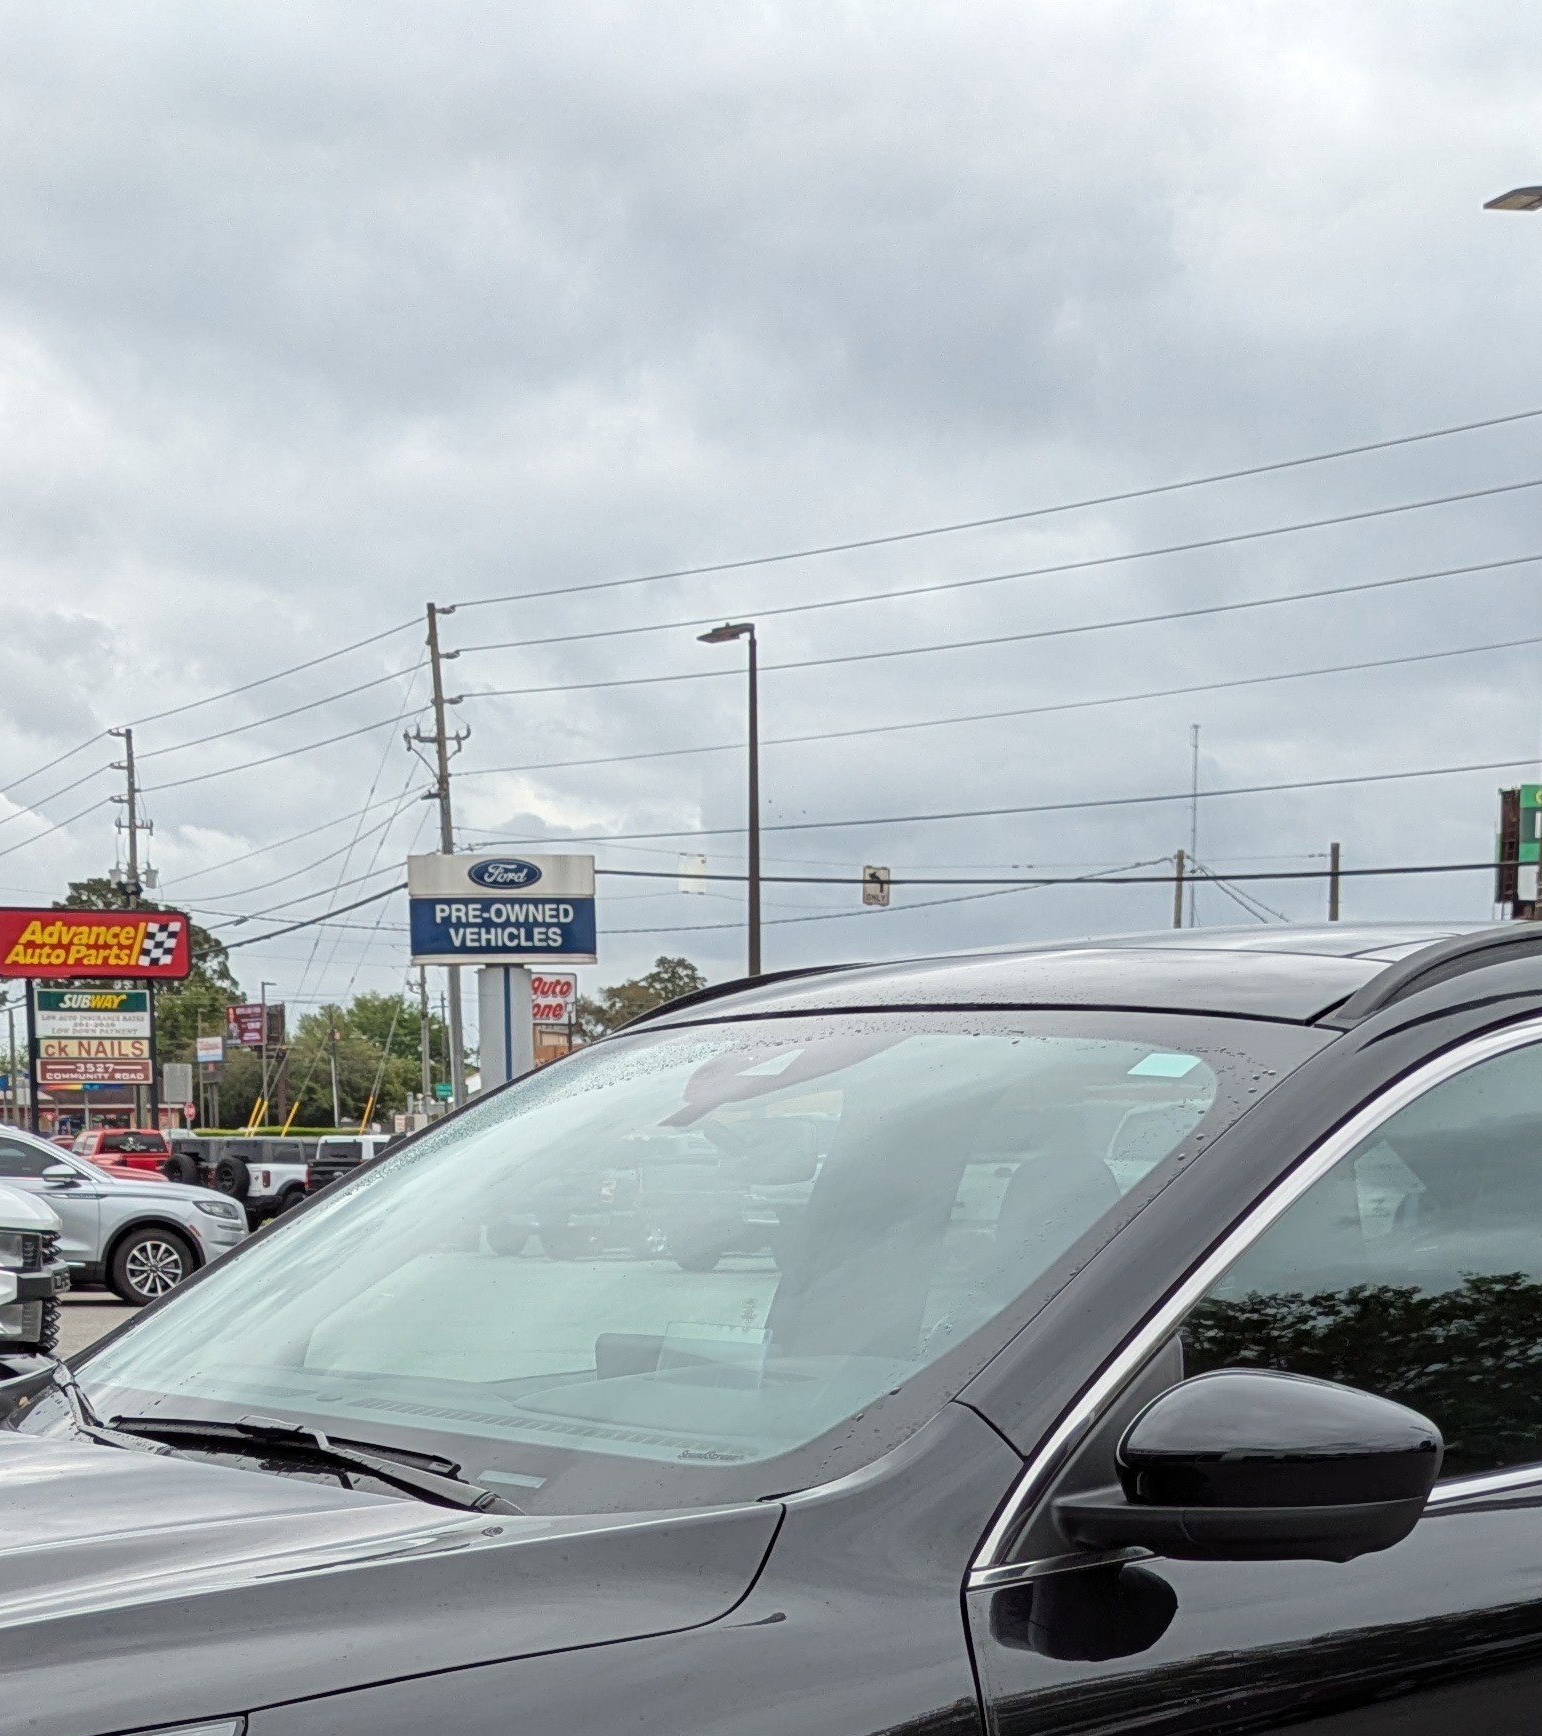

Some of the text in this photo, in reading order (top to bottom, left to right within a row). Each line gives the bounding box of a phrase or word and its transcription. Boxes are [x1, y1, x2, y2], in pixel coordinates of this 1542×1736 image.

[483, 864, 528, 882] Ford
[435, 904, 574, 923] PRE-OWNED
[18, 920, 136, 946] Advance
[449, 928, 563, 947] VEHICLES
[4, 945, 130, 966] Auto Parts
[531, 977, 573, 996] Auto
[59, 994, 127, 1009] SUBWAY
[532, 1003, 564, 1018] one
[45, 1041, 144, 1057] ck NAILS
[76, 1063, 114, 1073] 3527
